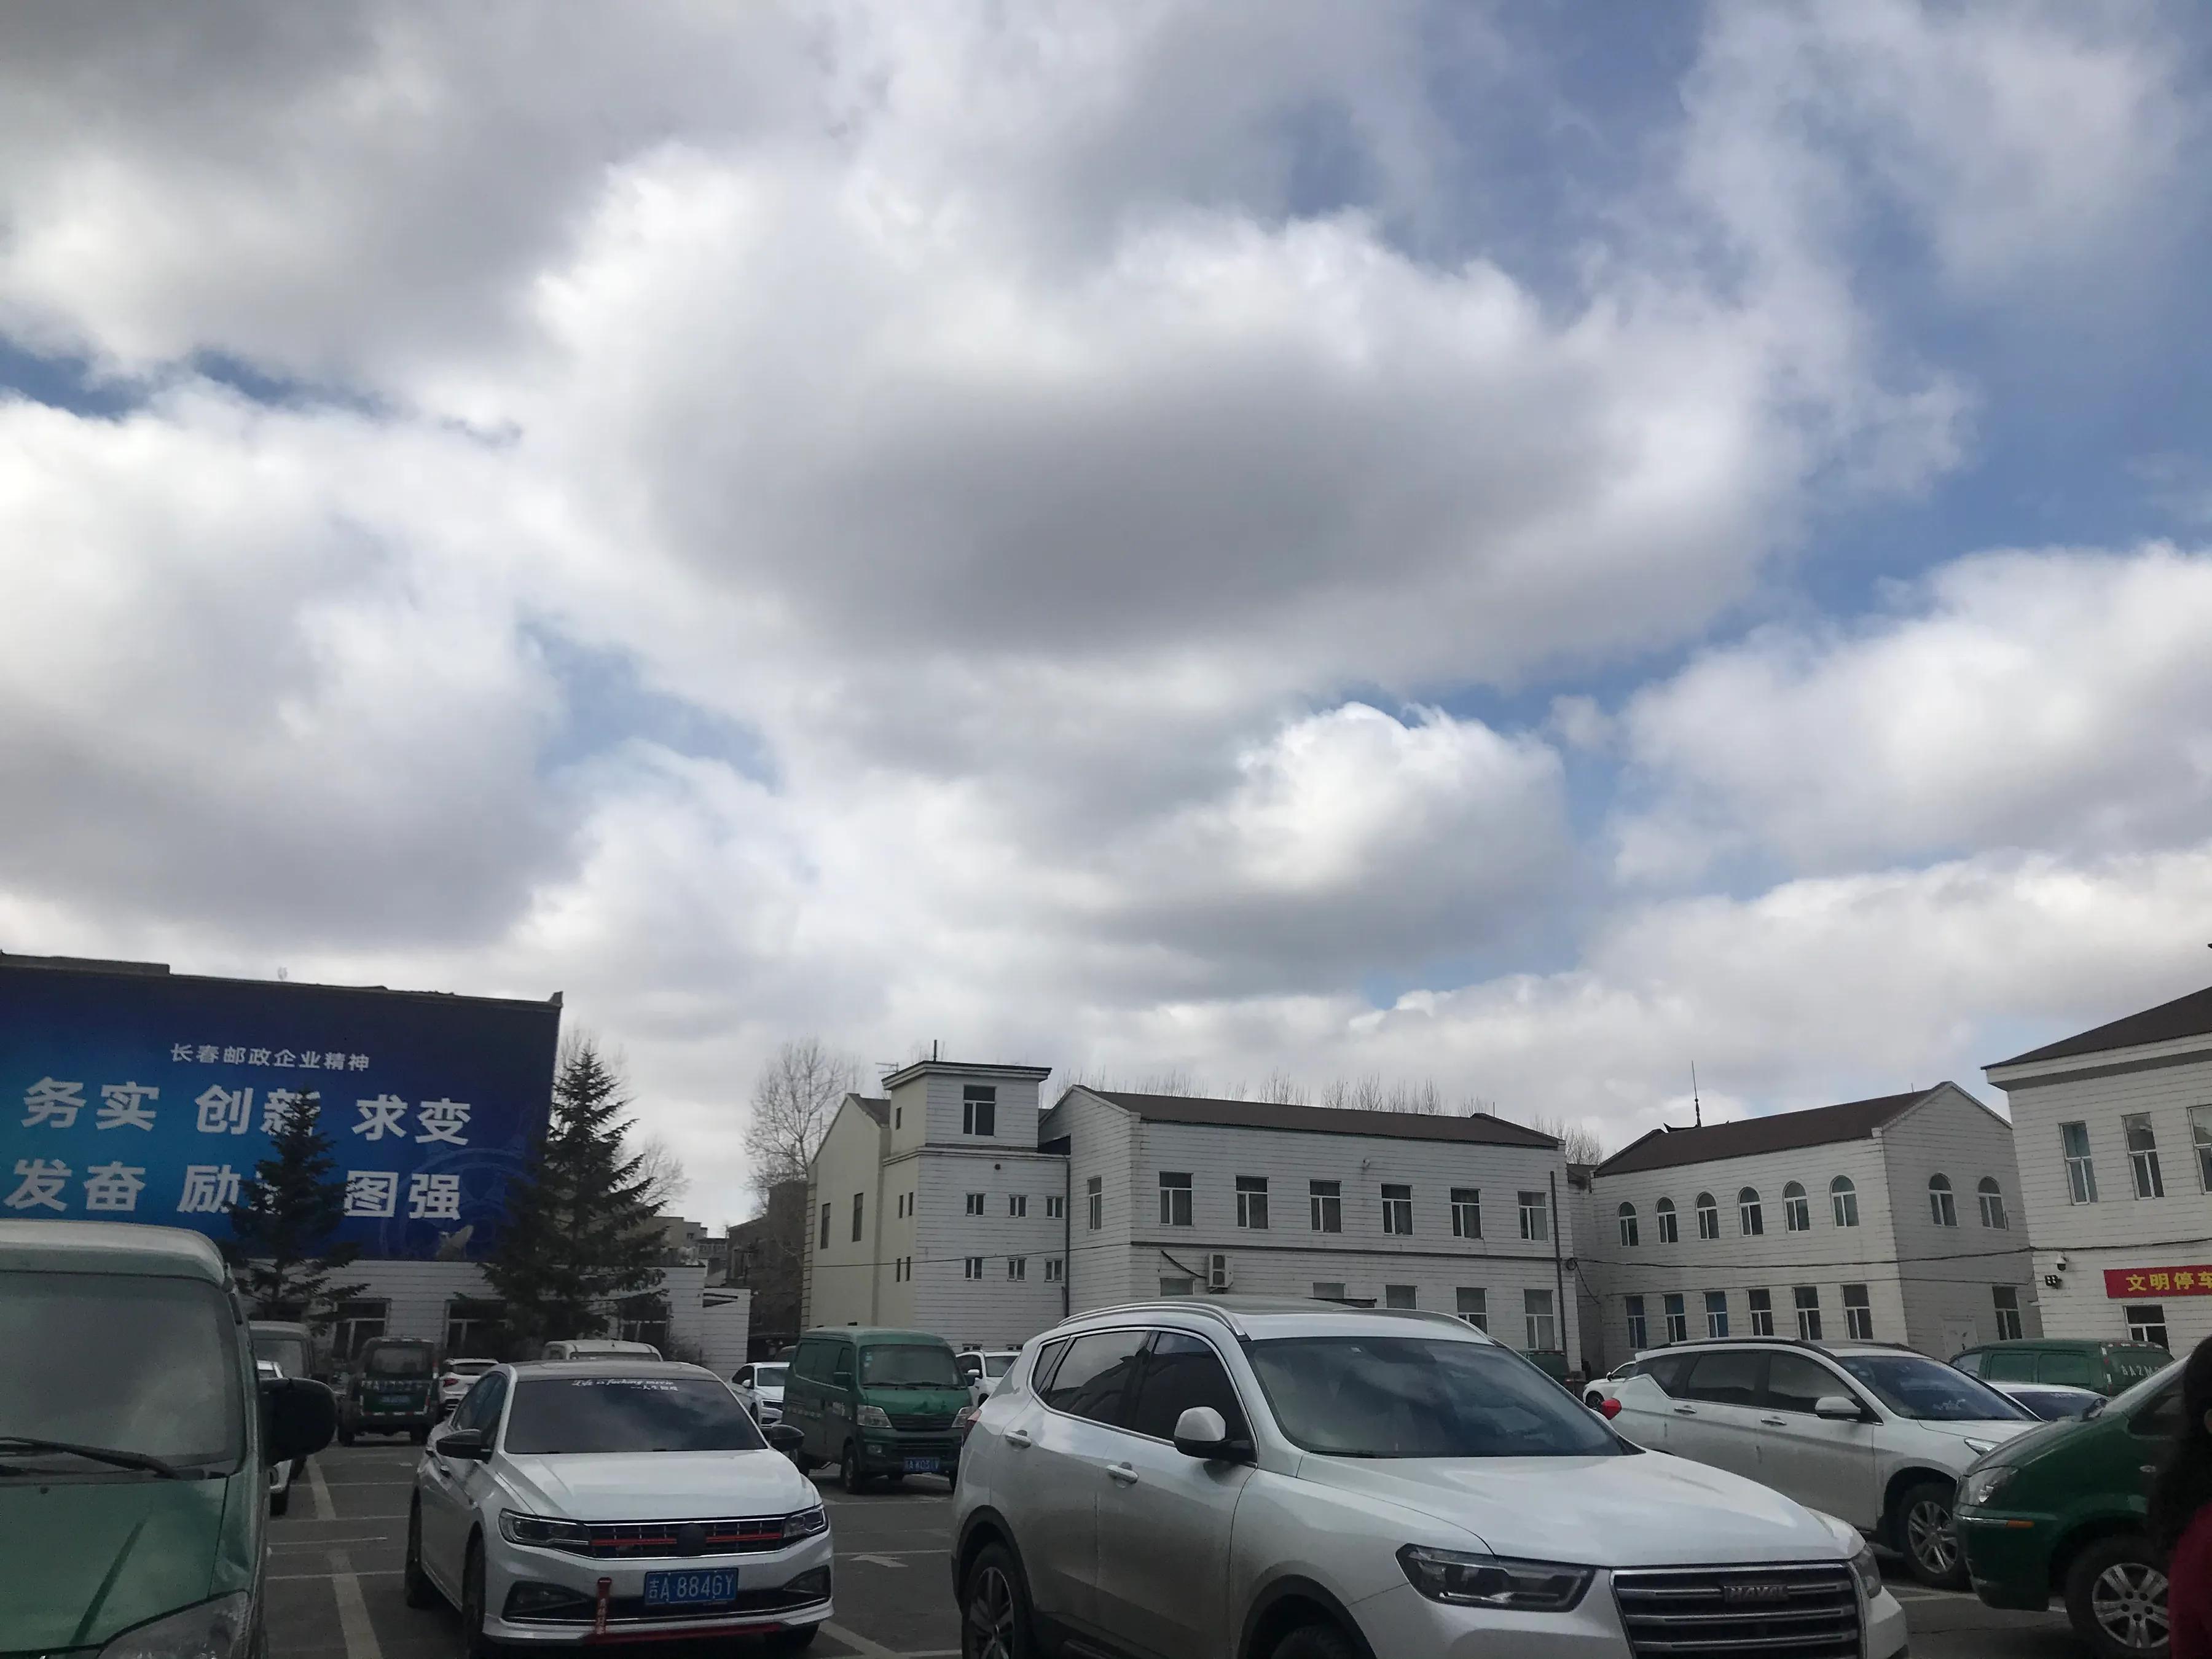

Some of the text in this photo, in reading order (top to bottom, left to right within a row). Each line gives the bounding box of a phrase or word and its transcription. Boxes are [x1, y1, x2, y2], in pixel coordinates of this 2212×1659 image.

[170, 1043, 369, 1072] 长春邮政企业精神
[20, 1077, 160, 1132] 务实
[352, 1094, 471, 1145] 求变
[4, 1159, 461, 1221] 发奋 励 图强
[2125, 1271, 2212, 1292] 文明停车
